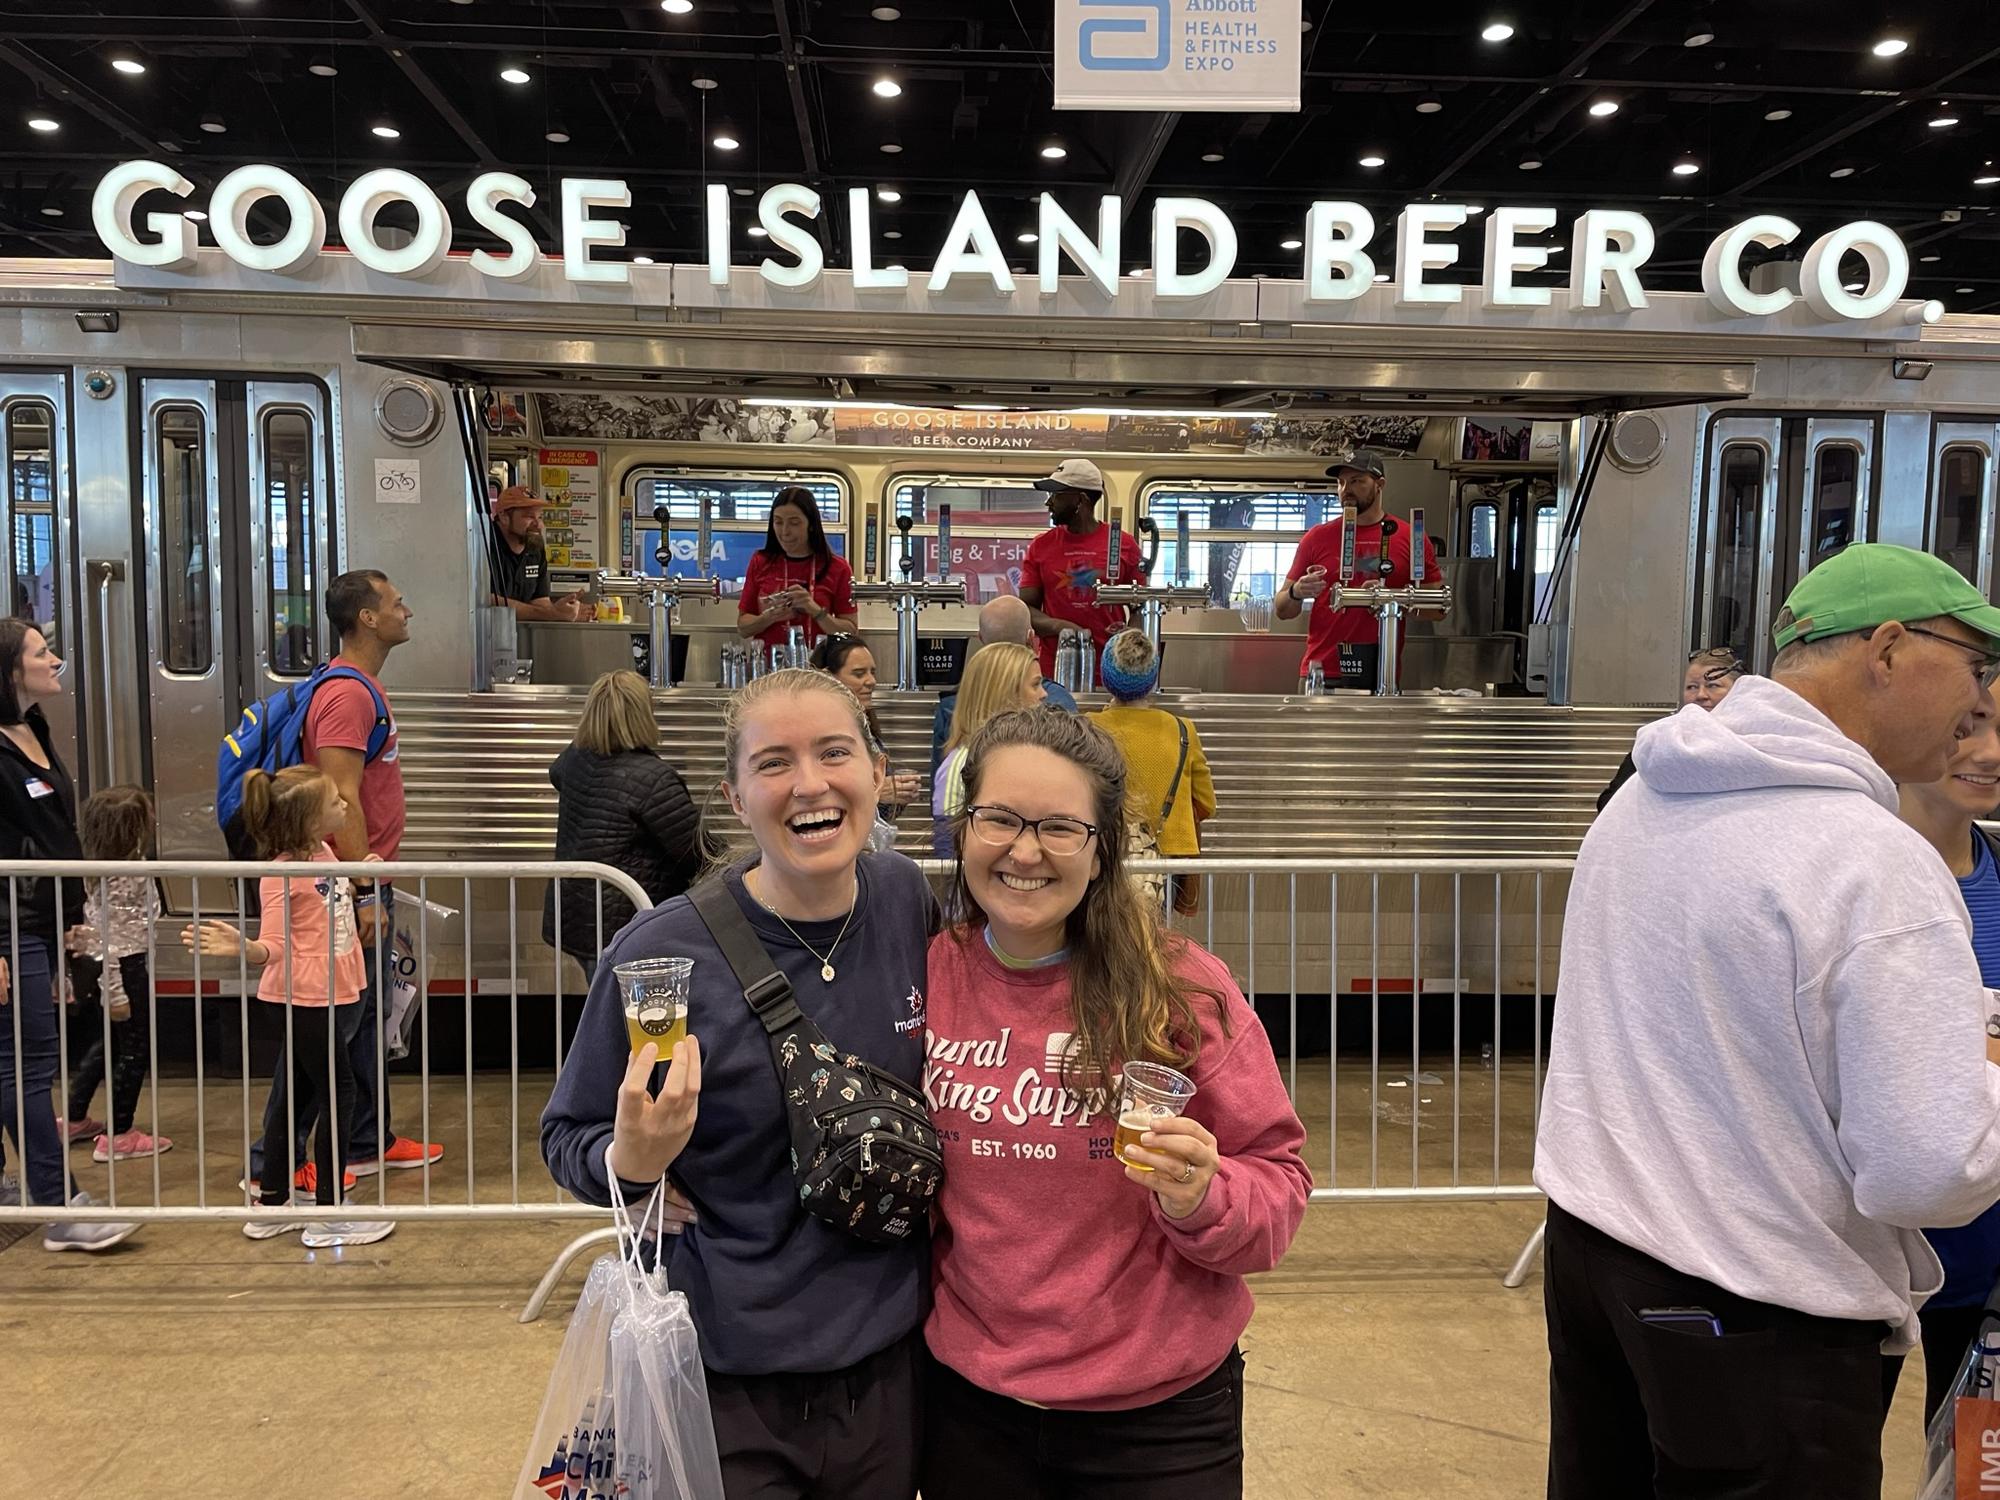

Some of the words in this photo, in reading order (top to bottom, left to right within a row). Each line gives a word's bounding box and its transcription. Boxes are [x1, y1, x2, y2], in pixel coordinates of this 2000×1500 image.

[1185, 0, 1258, 14] Abbott
[1185, 21, 1258, 37] HEALTH
[1185, 39, 1196, 53] &
[1202, 40, 1277, 54] FITNESS
[1185, 57, 1235, 71] EXPO
[91, 160, 633, 284] GOOSE
[705, 183, 1239, 300] ISLAND
[1303, 200, 1656, 313] BEER
[873, 411, 963, 428] GOOSE
[976, 414, 1072, 431] ISLAND
[912, 435, 951, 446] BEER
[956, 436, 1033, 448] COMPANY
[931, 544, 963, 563] Bg
[968, 544, 983, 561] &
[643, 999, 670, 1009] GOOSE
[645, 1020, 671, 1033] ISLAND
[971, 1138, 1006, 1158] EST.
[1012, 1142, 1057, 1160] 1960
